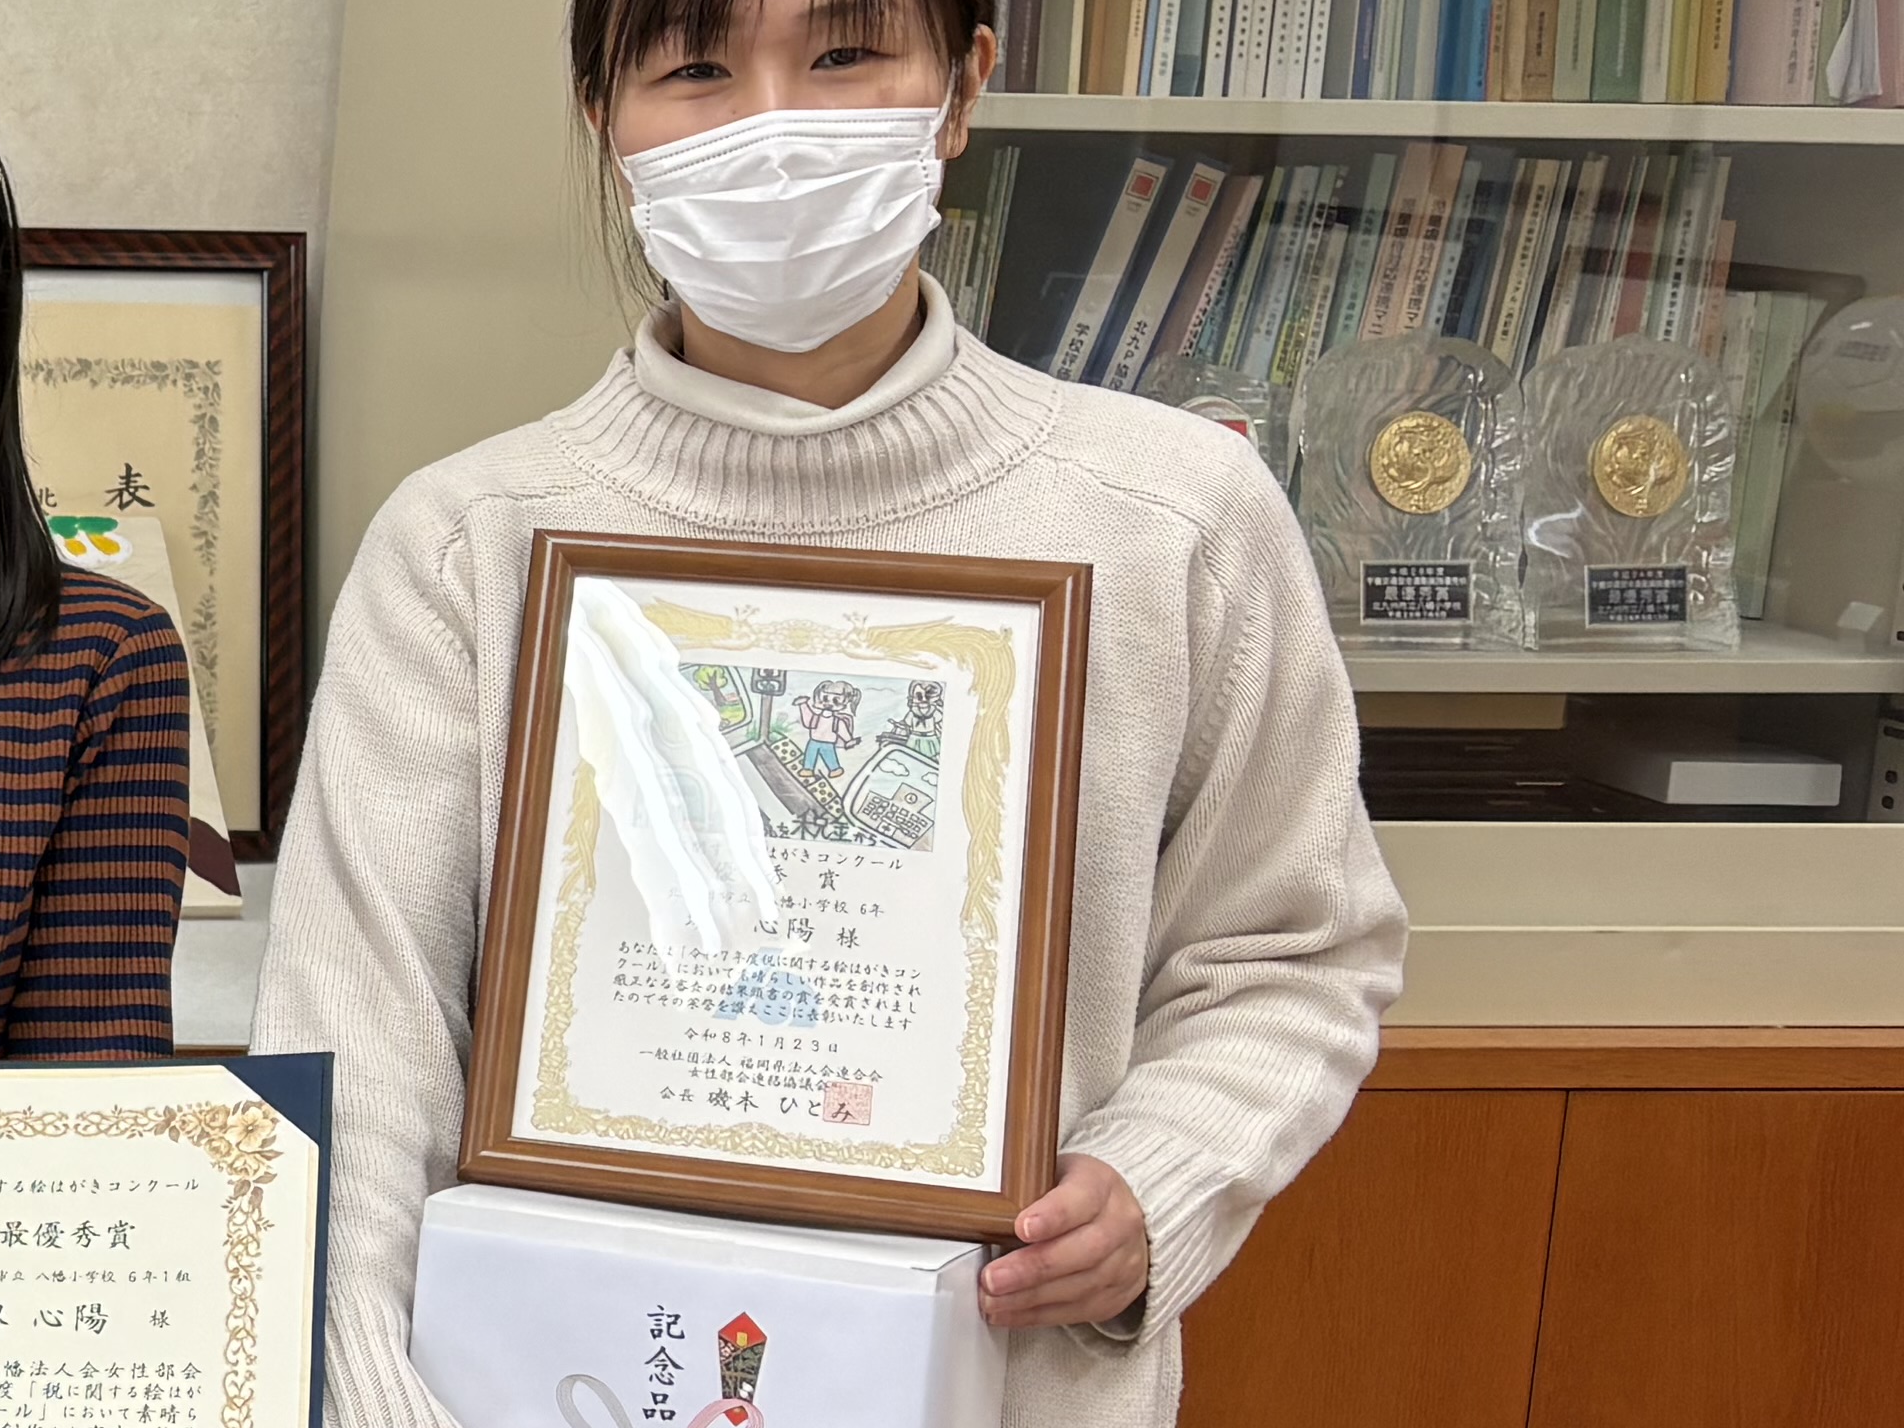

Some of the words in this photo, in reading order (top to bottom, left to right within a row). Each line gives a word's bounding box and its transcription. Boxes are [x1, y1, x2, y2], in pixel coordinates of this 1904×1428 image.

[103, 462, 156, 511] 表
[837, 926, 860, 948] 様
[660, 1086, 694, 1104] 会長
[35, 1269, 117, 1284] 八幡小学校
[33, 1302, 109, 1334] 心陽
[149, 1309, 171, 1329] 様
[642, 1304, 686, 1423] 記念品
